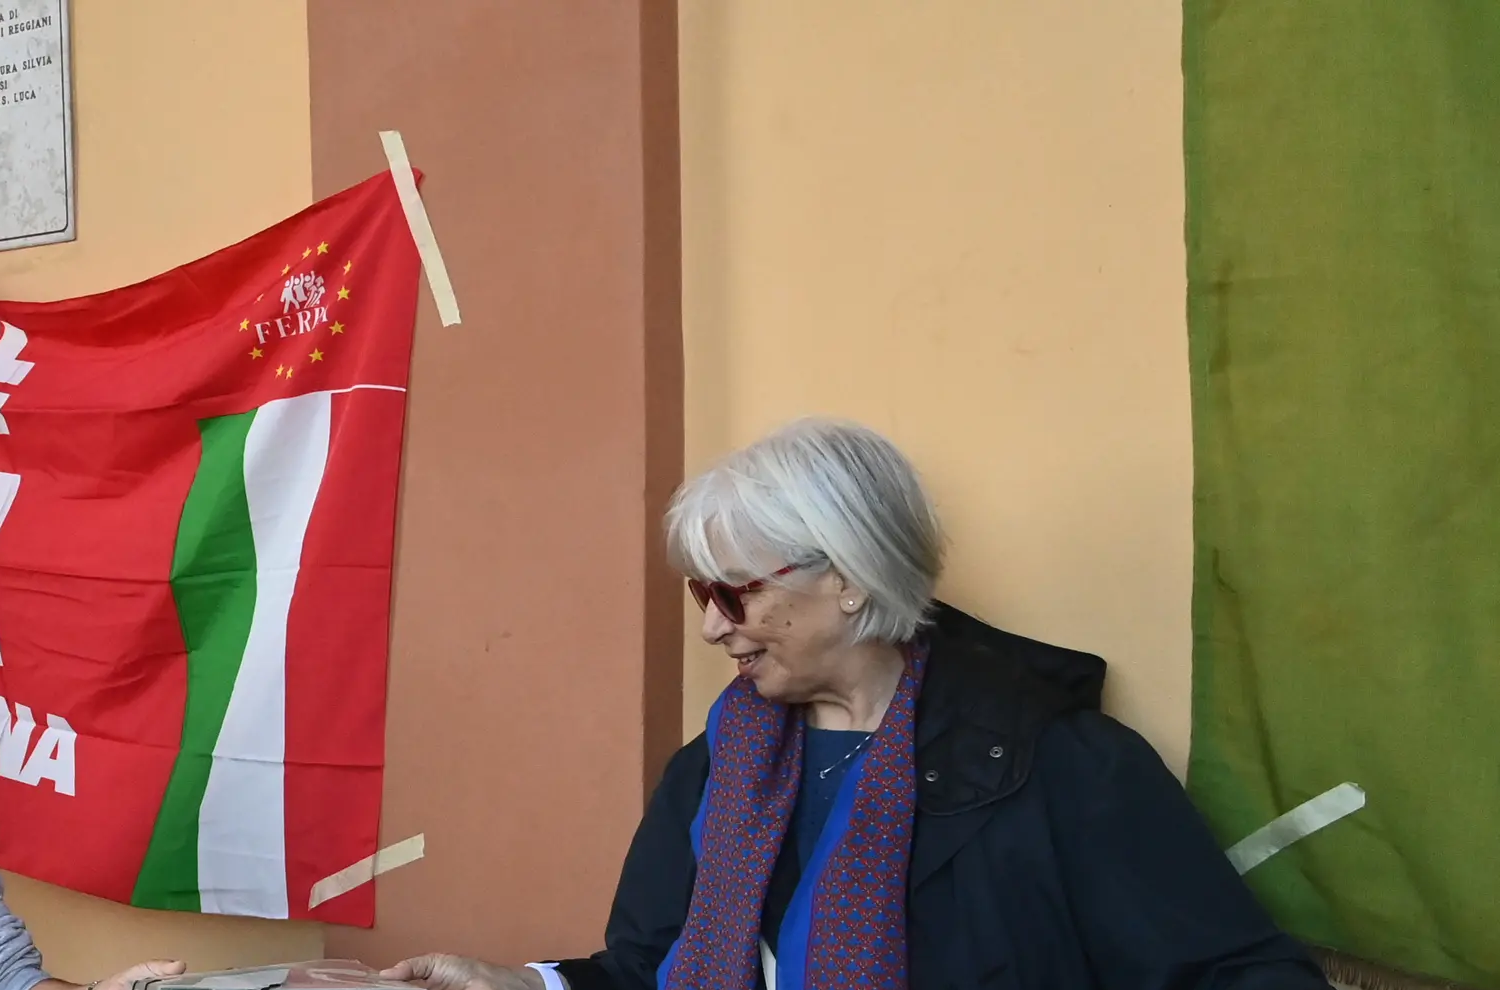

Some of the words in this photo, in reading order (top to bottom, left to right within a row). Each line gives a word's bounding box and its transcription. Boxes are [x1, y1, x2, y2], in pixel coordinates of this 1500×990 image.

[9, 8, 19, 20] DI
[8, 15, 52, 36] REGGIANI
[22, 55, 52, 71] SILVIA
[1, 96, 10, 106] S.
[14, 90, 37, 103] LUCA
